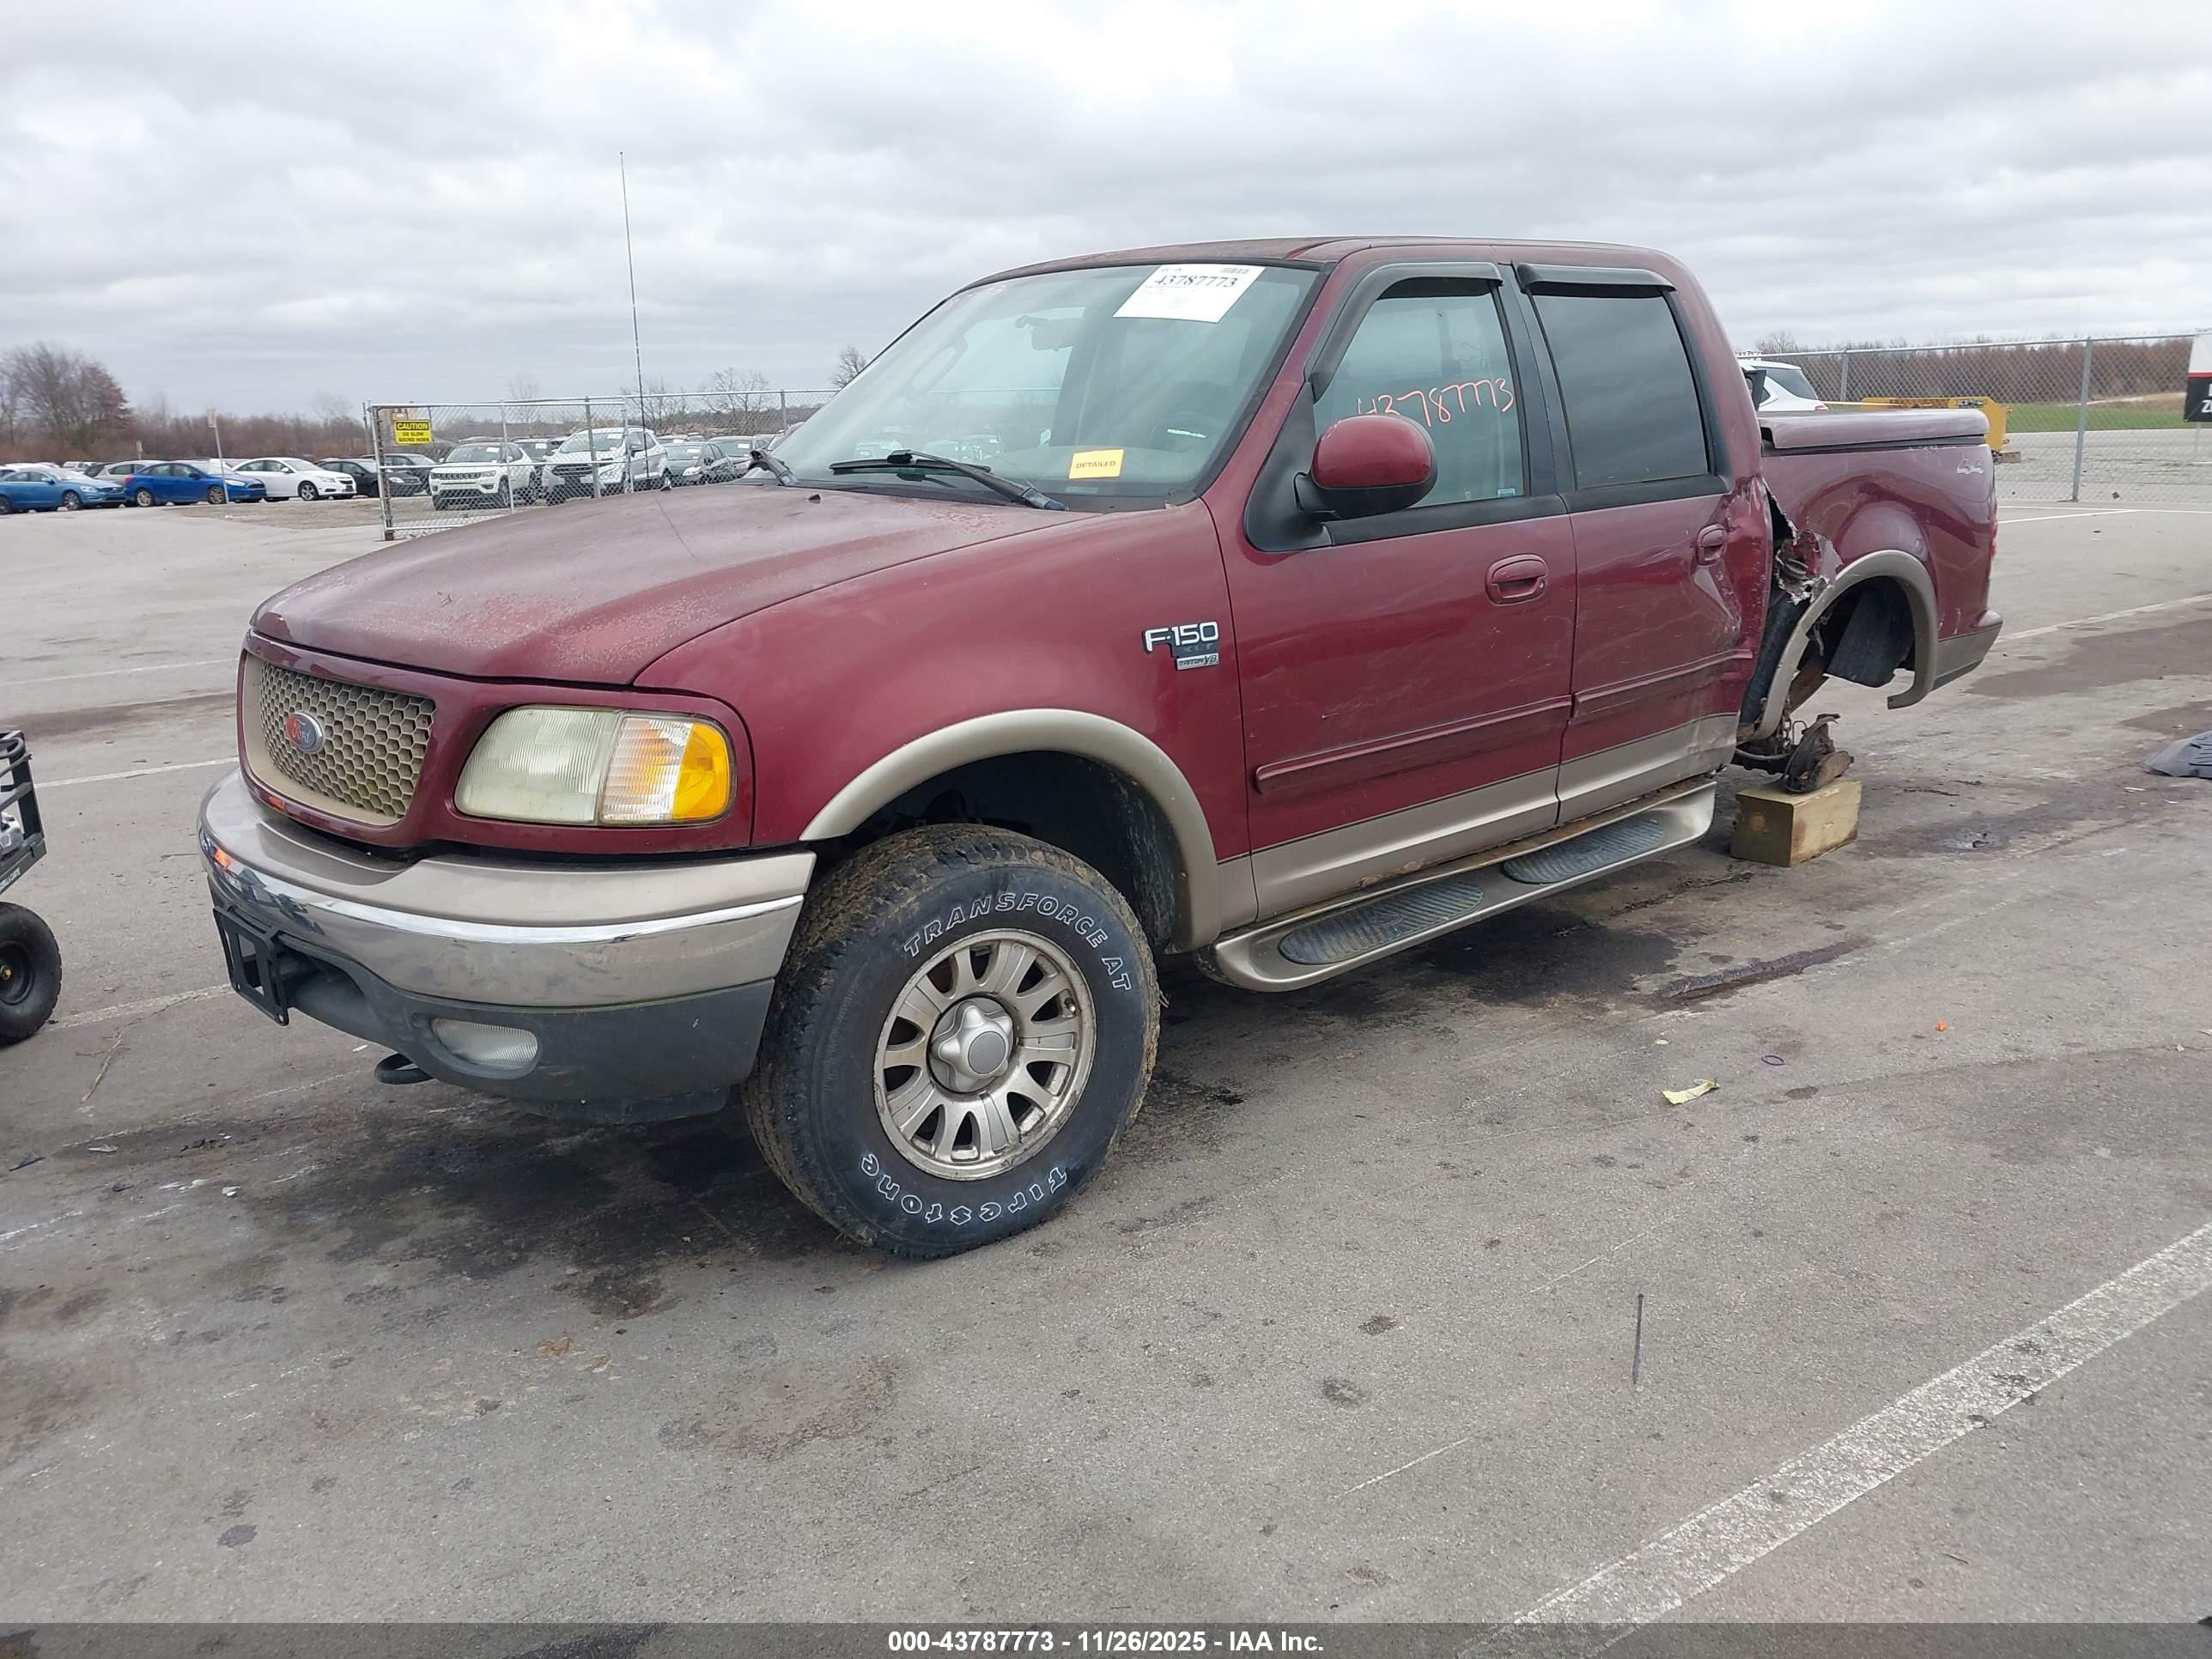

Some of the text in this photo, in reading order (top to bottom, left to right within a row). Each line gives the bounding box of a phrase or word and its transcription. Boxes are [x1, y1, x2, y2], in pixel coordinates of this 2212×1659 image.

[1154, 275, 1237, 288] 43787773
[1076, 460, 1116, 469] DETAILED
[903, 892, 1132, 991] TRANSFORCE AT
[861, 1153, 1067, 1225] Firestone
